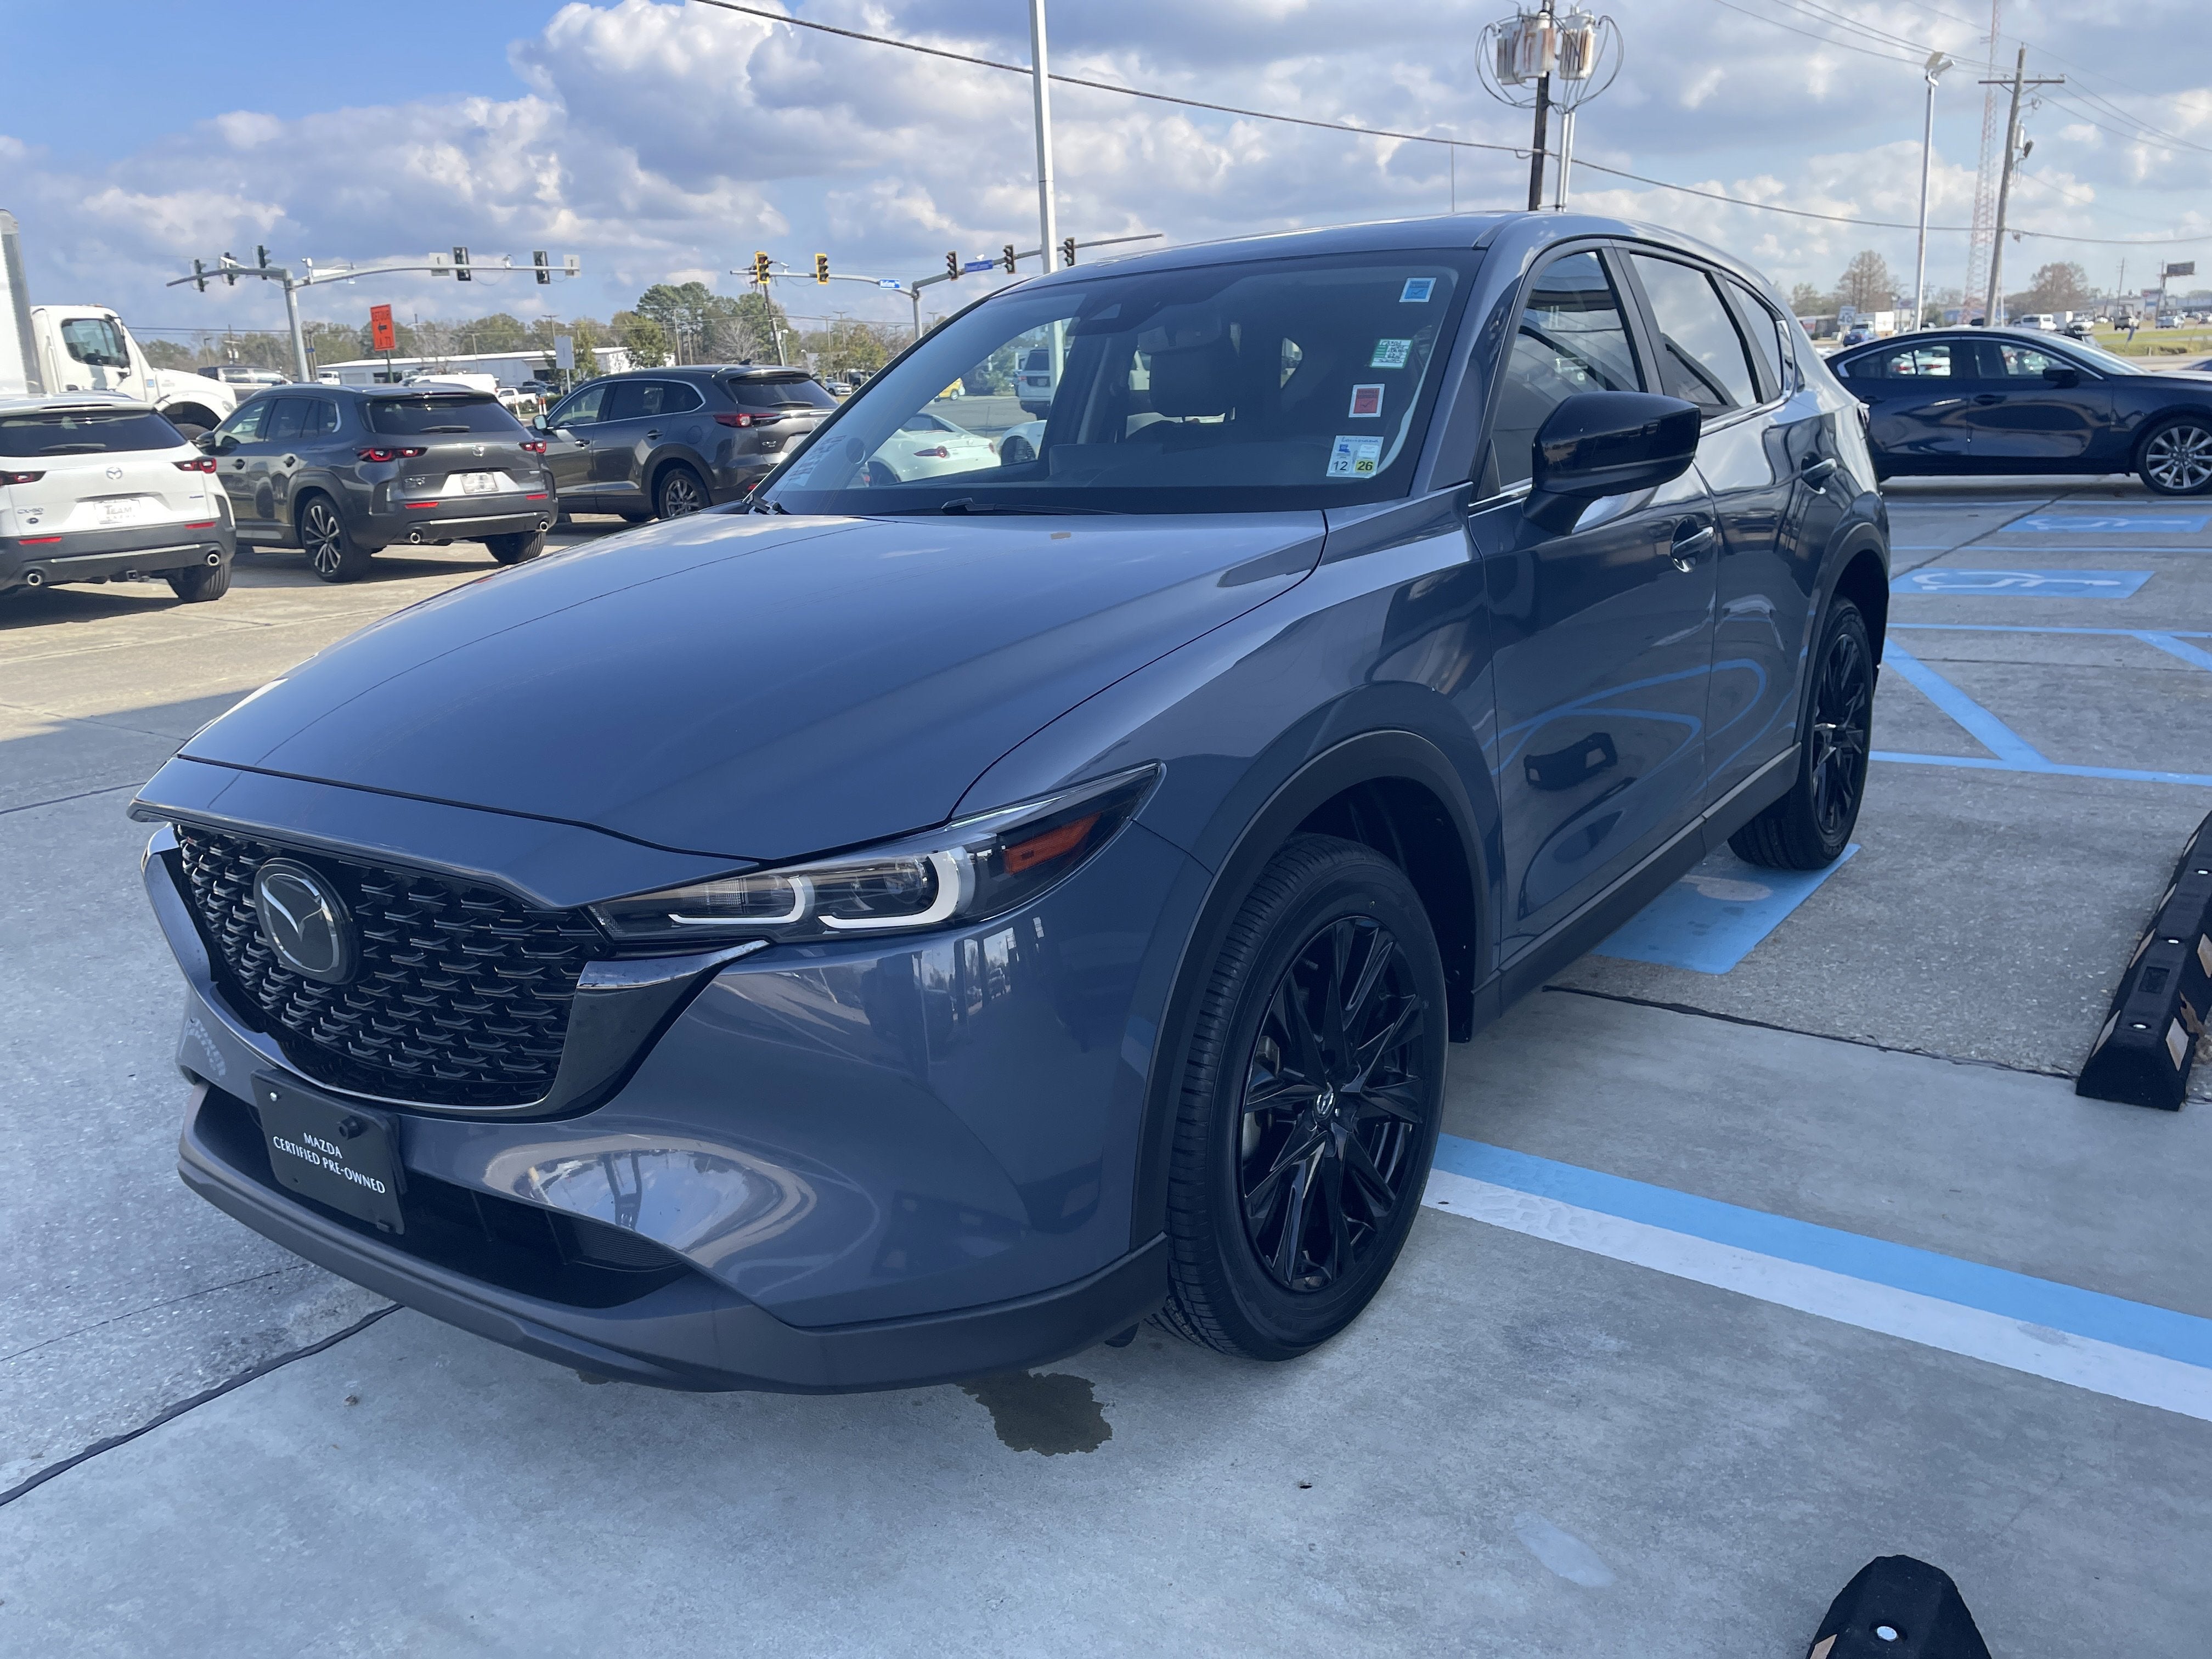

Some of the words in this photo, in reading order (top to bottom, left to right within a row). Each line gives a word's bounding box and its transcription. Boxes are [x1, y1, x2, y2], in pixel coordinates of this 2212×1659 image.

[1334, 461, 1348, 471] 12
[1357, 461, 1373, 471] 26
[303, 1132, 343, 1159] MAZDA
[273, 1136, 320, 1165] CERTIFIED
[322, 1156, 386, 1194] PRE-OWNED
